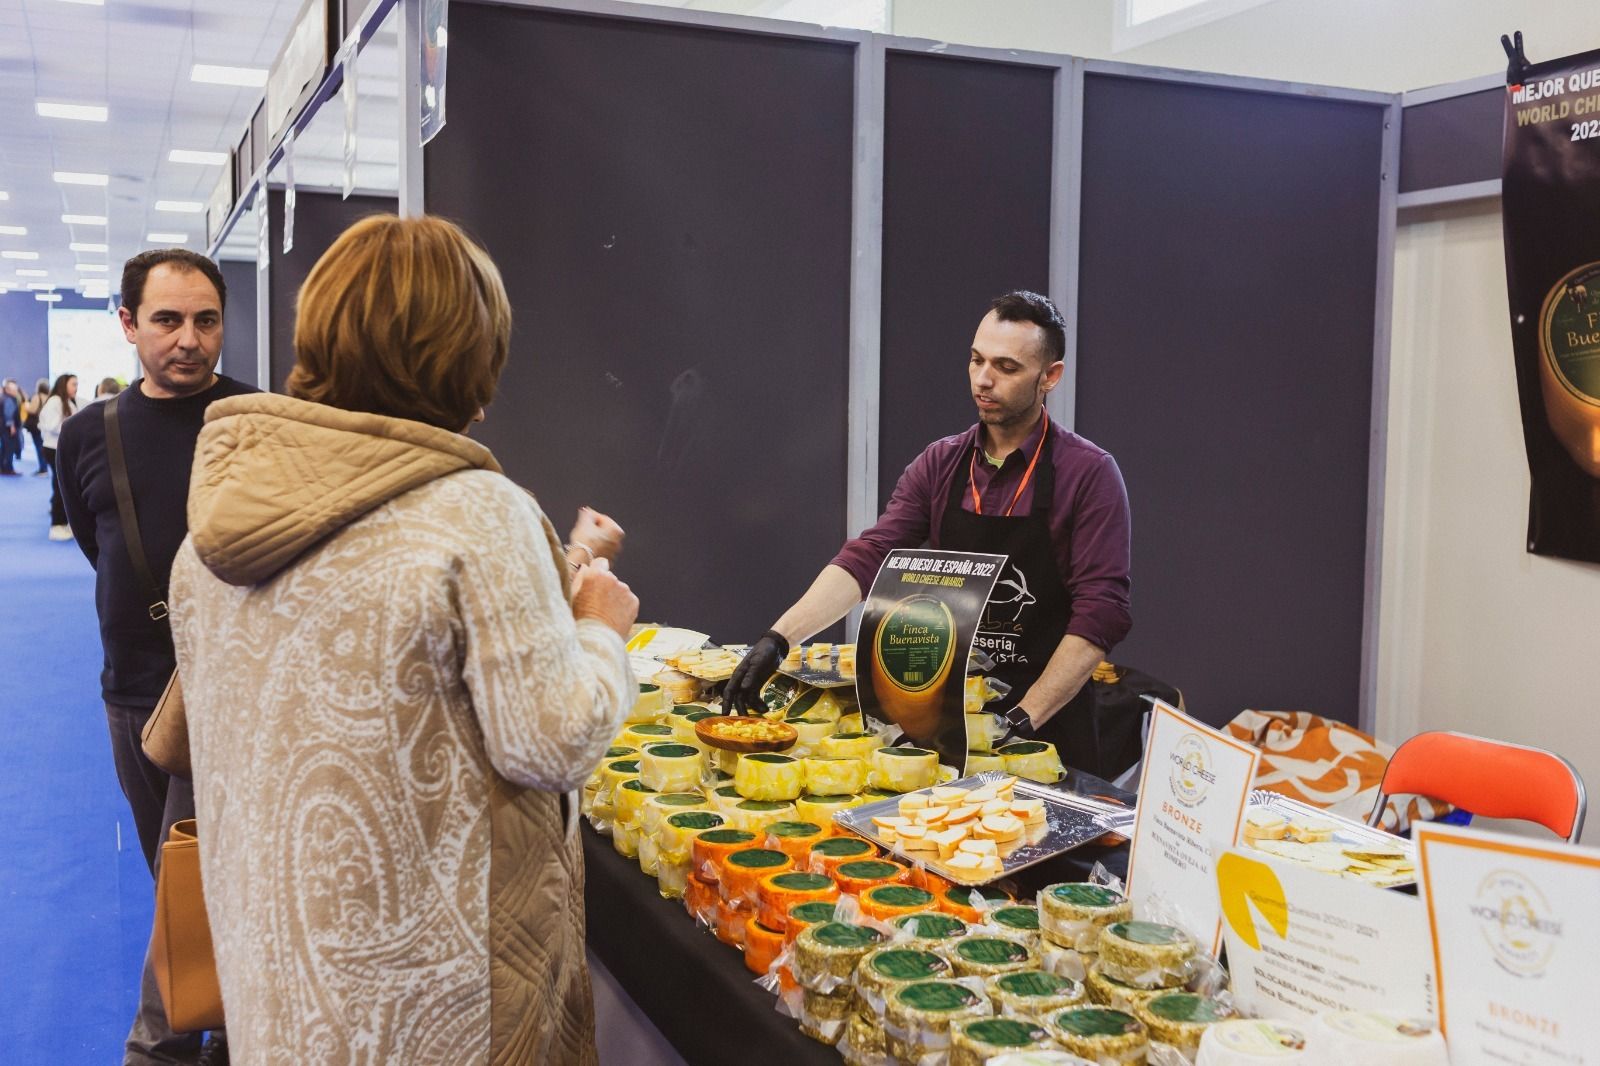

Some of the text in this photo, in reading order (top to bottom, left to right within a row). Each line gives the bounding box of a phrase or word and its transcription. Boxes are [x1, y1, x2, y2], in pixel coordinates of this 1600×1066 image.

[1513, 78, 1564, 104] MEJOR
[1517, 101, 1569, 127] WORLD
[1571, 119, 1600, 141] 202
[887, 556, 995, 576] MEJOR QUESO DE ESPAÑA 2022
[901, 572, 920, 583] WORLD
[889, 633, 939, 645] Buenavista
[903, 623, 928, 634] Finca
[1169, 751, 1216, 785] WORLD CHEESE
[1162, 801, 1202, 834] BRONZE
